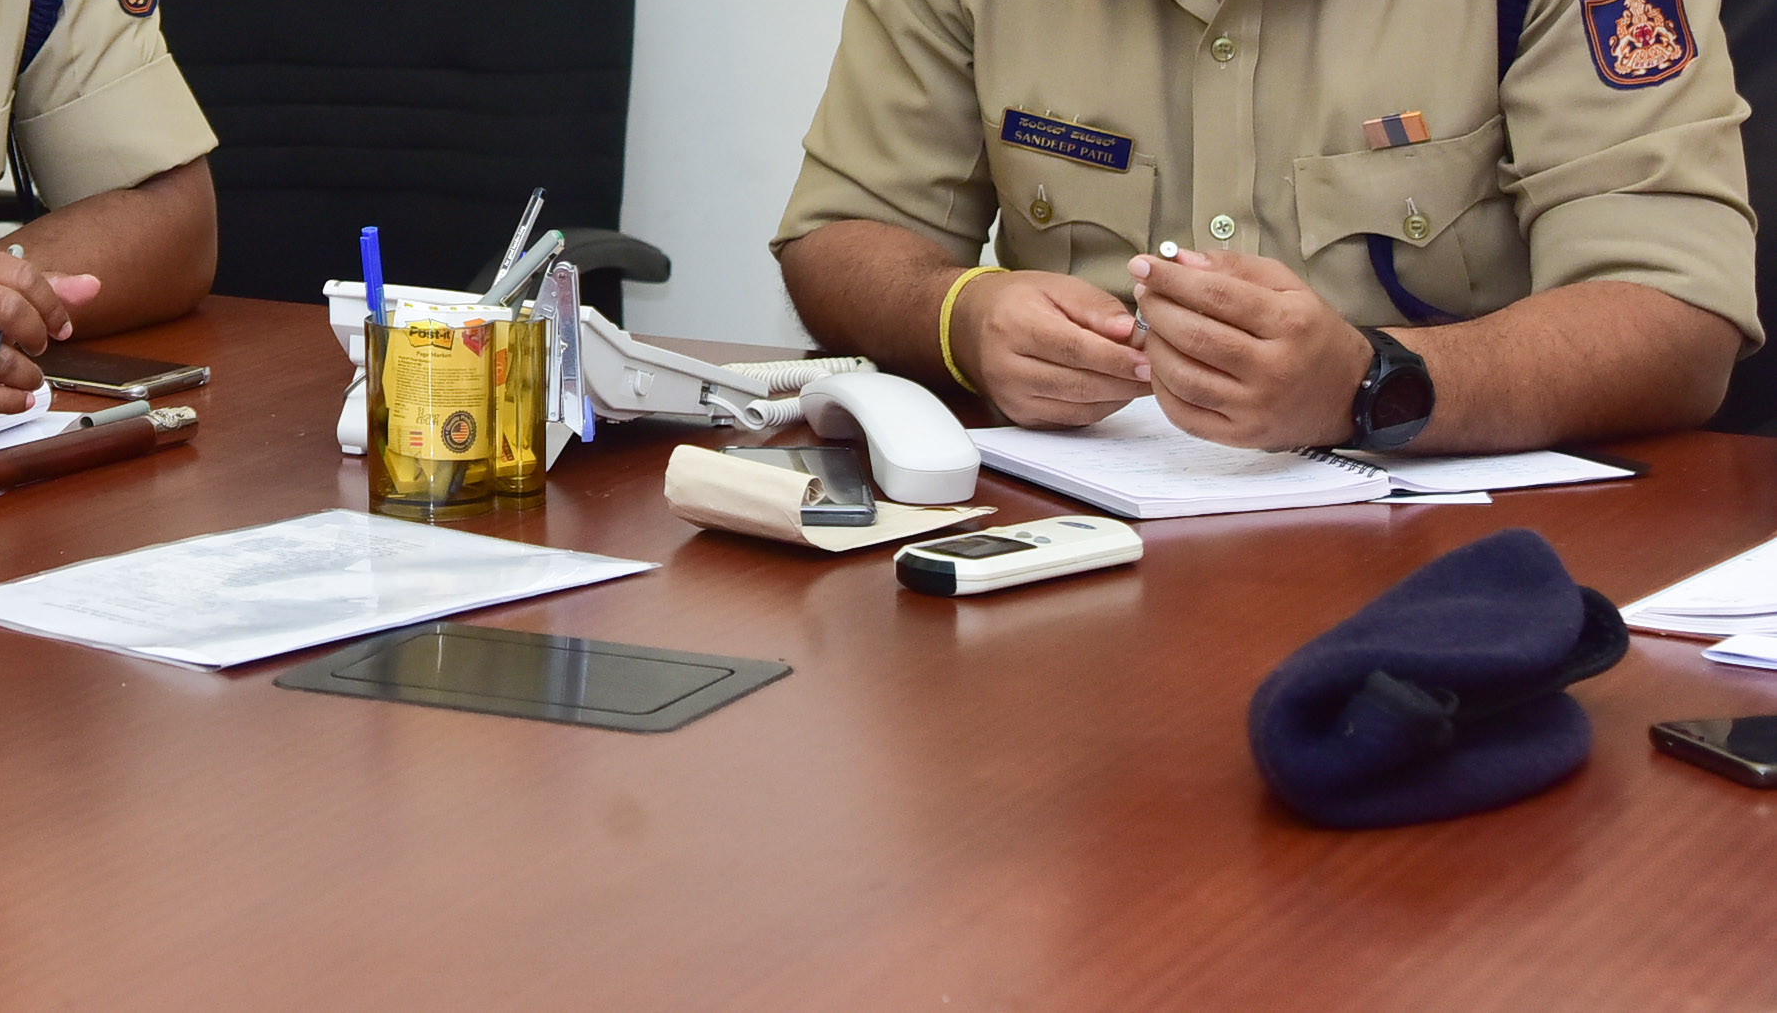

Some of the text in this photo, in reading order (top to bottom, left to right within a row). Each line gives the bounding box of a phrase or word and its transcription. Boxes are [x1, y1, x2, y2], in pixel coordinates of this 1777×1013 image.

[1013, 130, 1115, 164] SANDEEP PATIL
[409, 326, 451, 340] Post-it
[416, 350, 429, 358] Page
